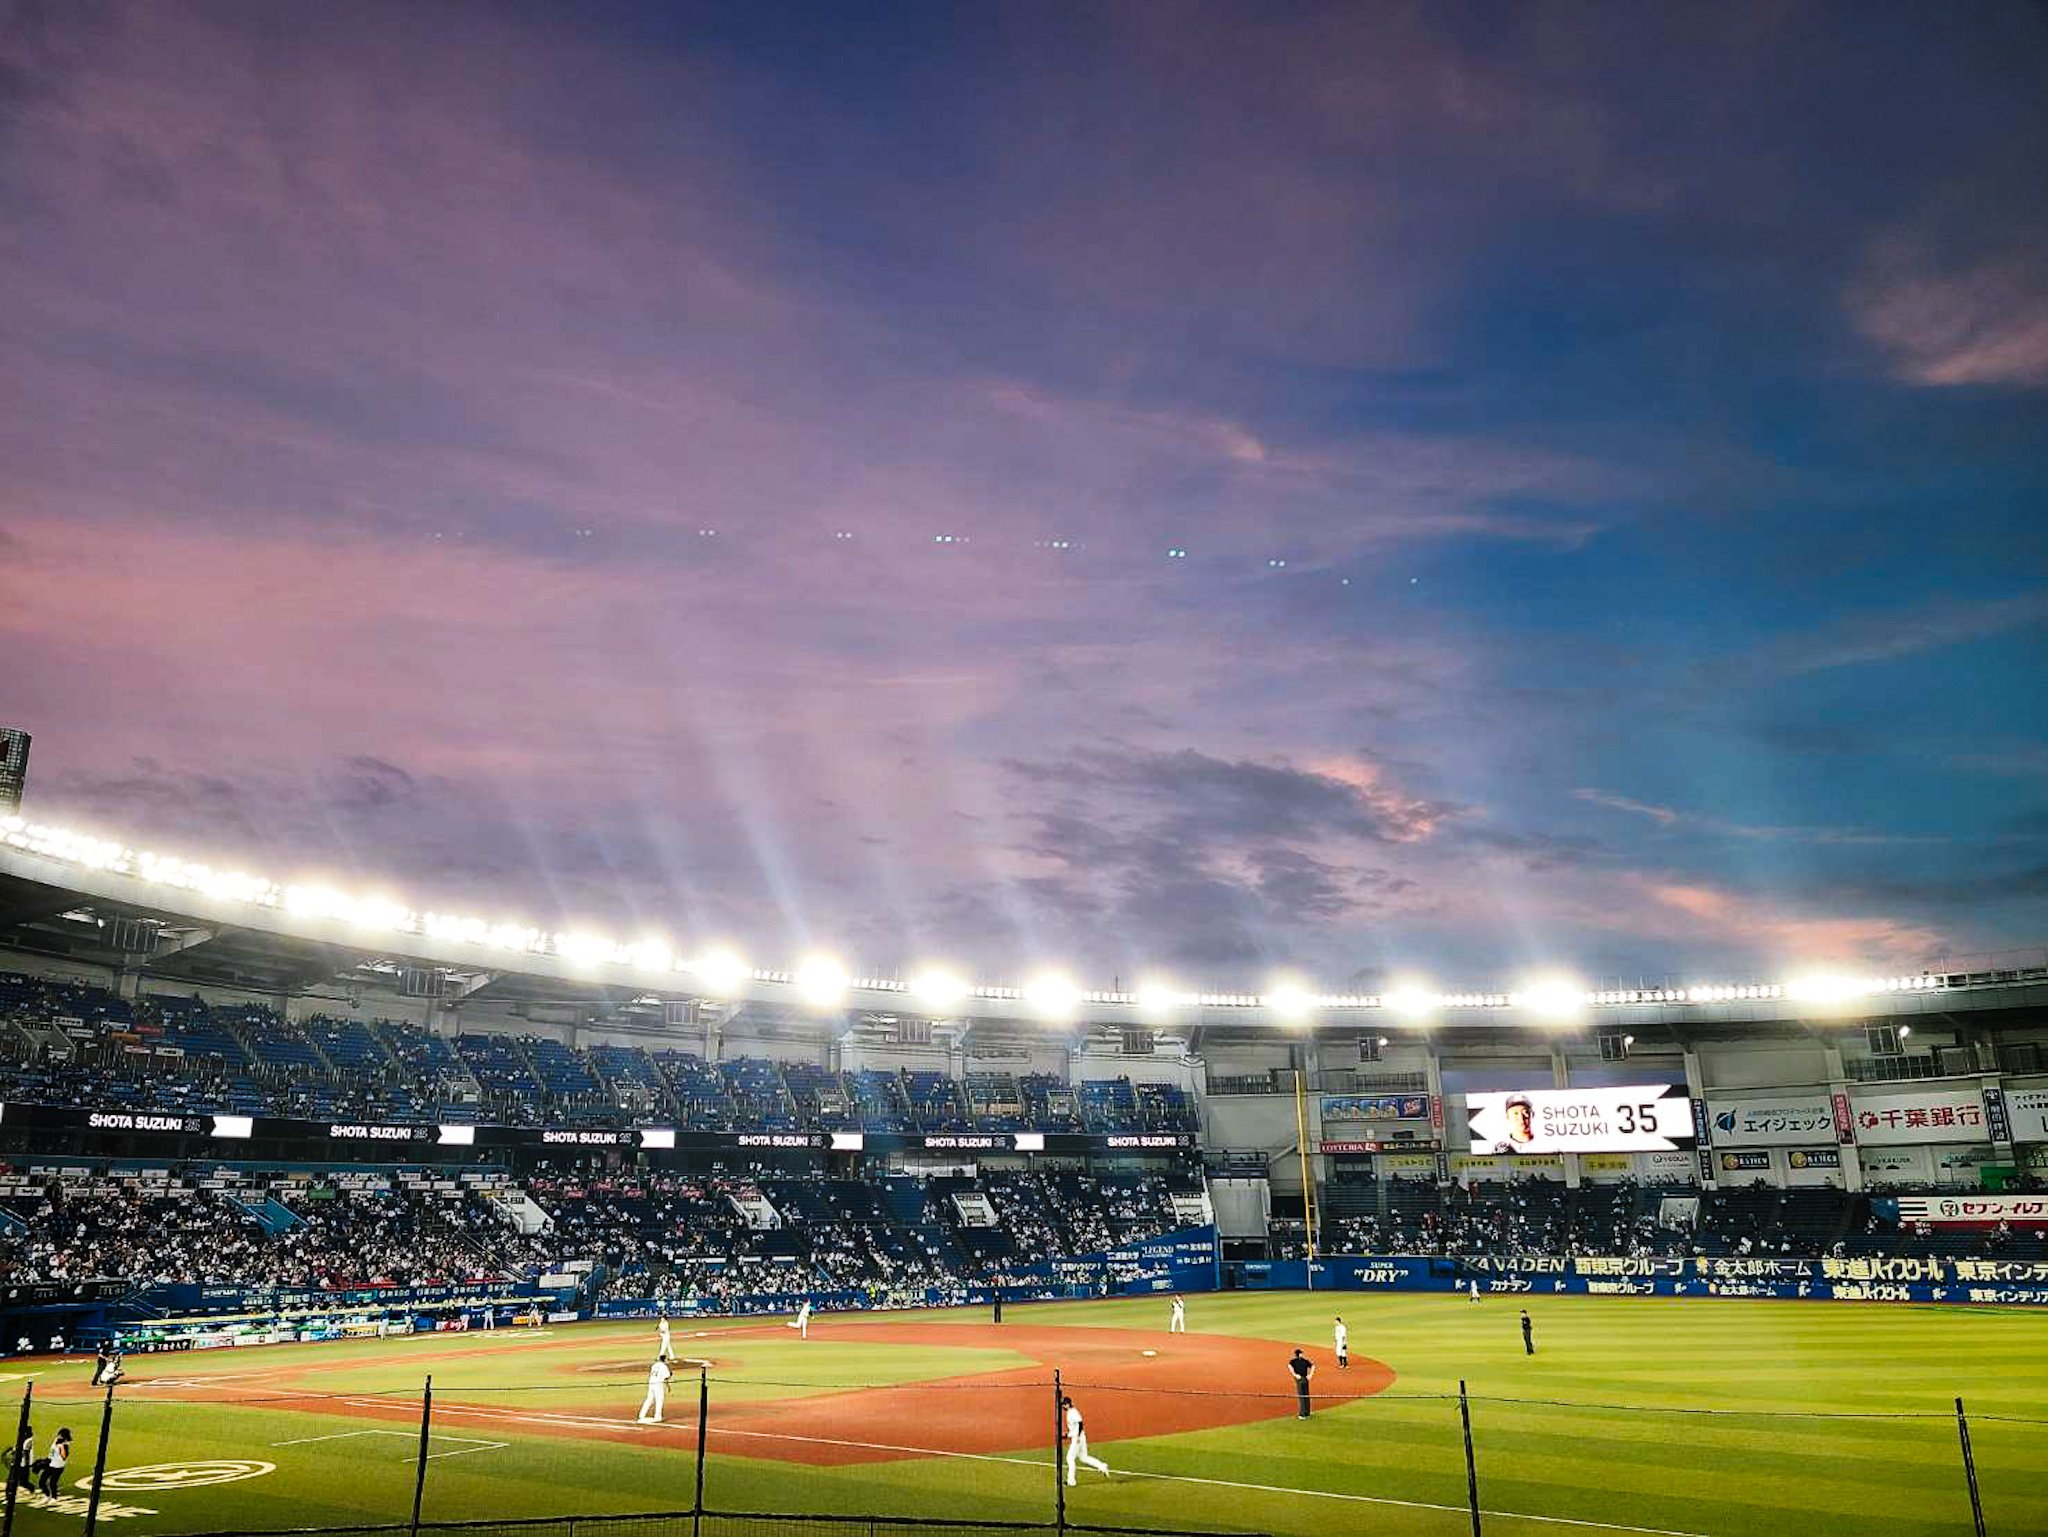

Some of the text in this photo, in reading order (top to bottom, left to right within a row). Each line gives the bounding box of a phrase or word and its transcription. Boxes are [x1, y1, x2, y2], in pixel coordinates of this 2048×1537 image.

[1542, 1105, 1600, 1120] SHOTA
[1617, 1104, 1657, 1134] 35
[1881, 1105, 1981, 1129] 千葉銀行
[88, 1113, 132, 1129] SHOTA
[135, 1115, 183, 1130] SUZUKI
[1744, 1116, 1831, 1133] エイジェック
[330, 1125, 368, 1138] SHOTA
[369, 1126, 411, 1140] SUZUKI
[1544, 1122, 1609, 1137] SUZUKI
[543, 1131, 578, 1143] SHOTA
[579, 1132, 617, 1144] SUZUKI
[738, 1135, 771, 1146] SHOTA
[772, 1135, 809, 1147] SUZUKI
[925, 1136, 957, 1147] SHOTA
[958, 1136, 993, 1148] SUZUKI
[1107, 1136, 1140, 1147] SHOTA
[1140, 1136, 1177, 1147] SUZUKI
[1714, 1259, 1812, 1276] 金太郎ホーム
[1822, 1258, 1944, 1281] 東進ハイスクール
[1490, 1280, 1532, 1292] カナデン
[1719, 1284, 1777, 1296] 金太郎ホーム
[1832, 1285, 1910, 1300] 東進ハイスクール
